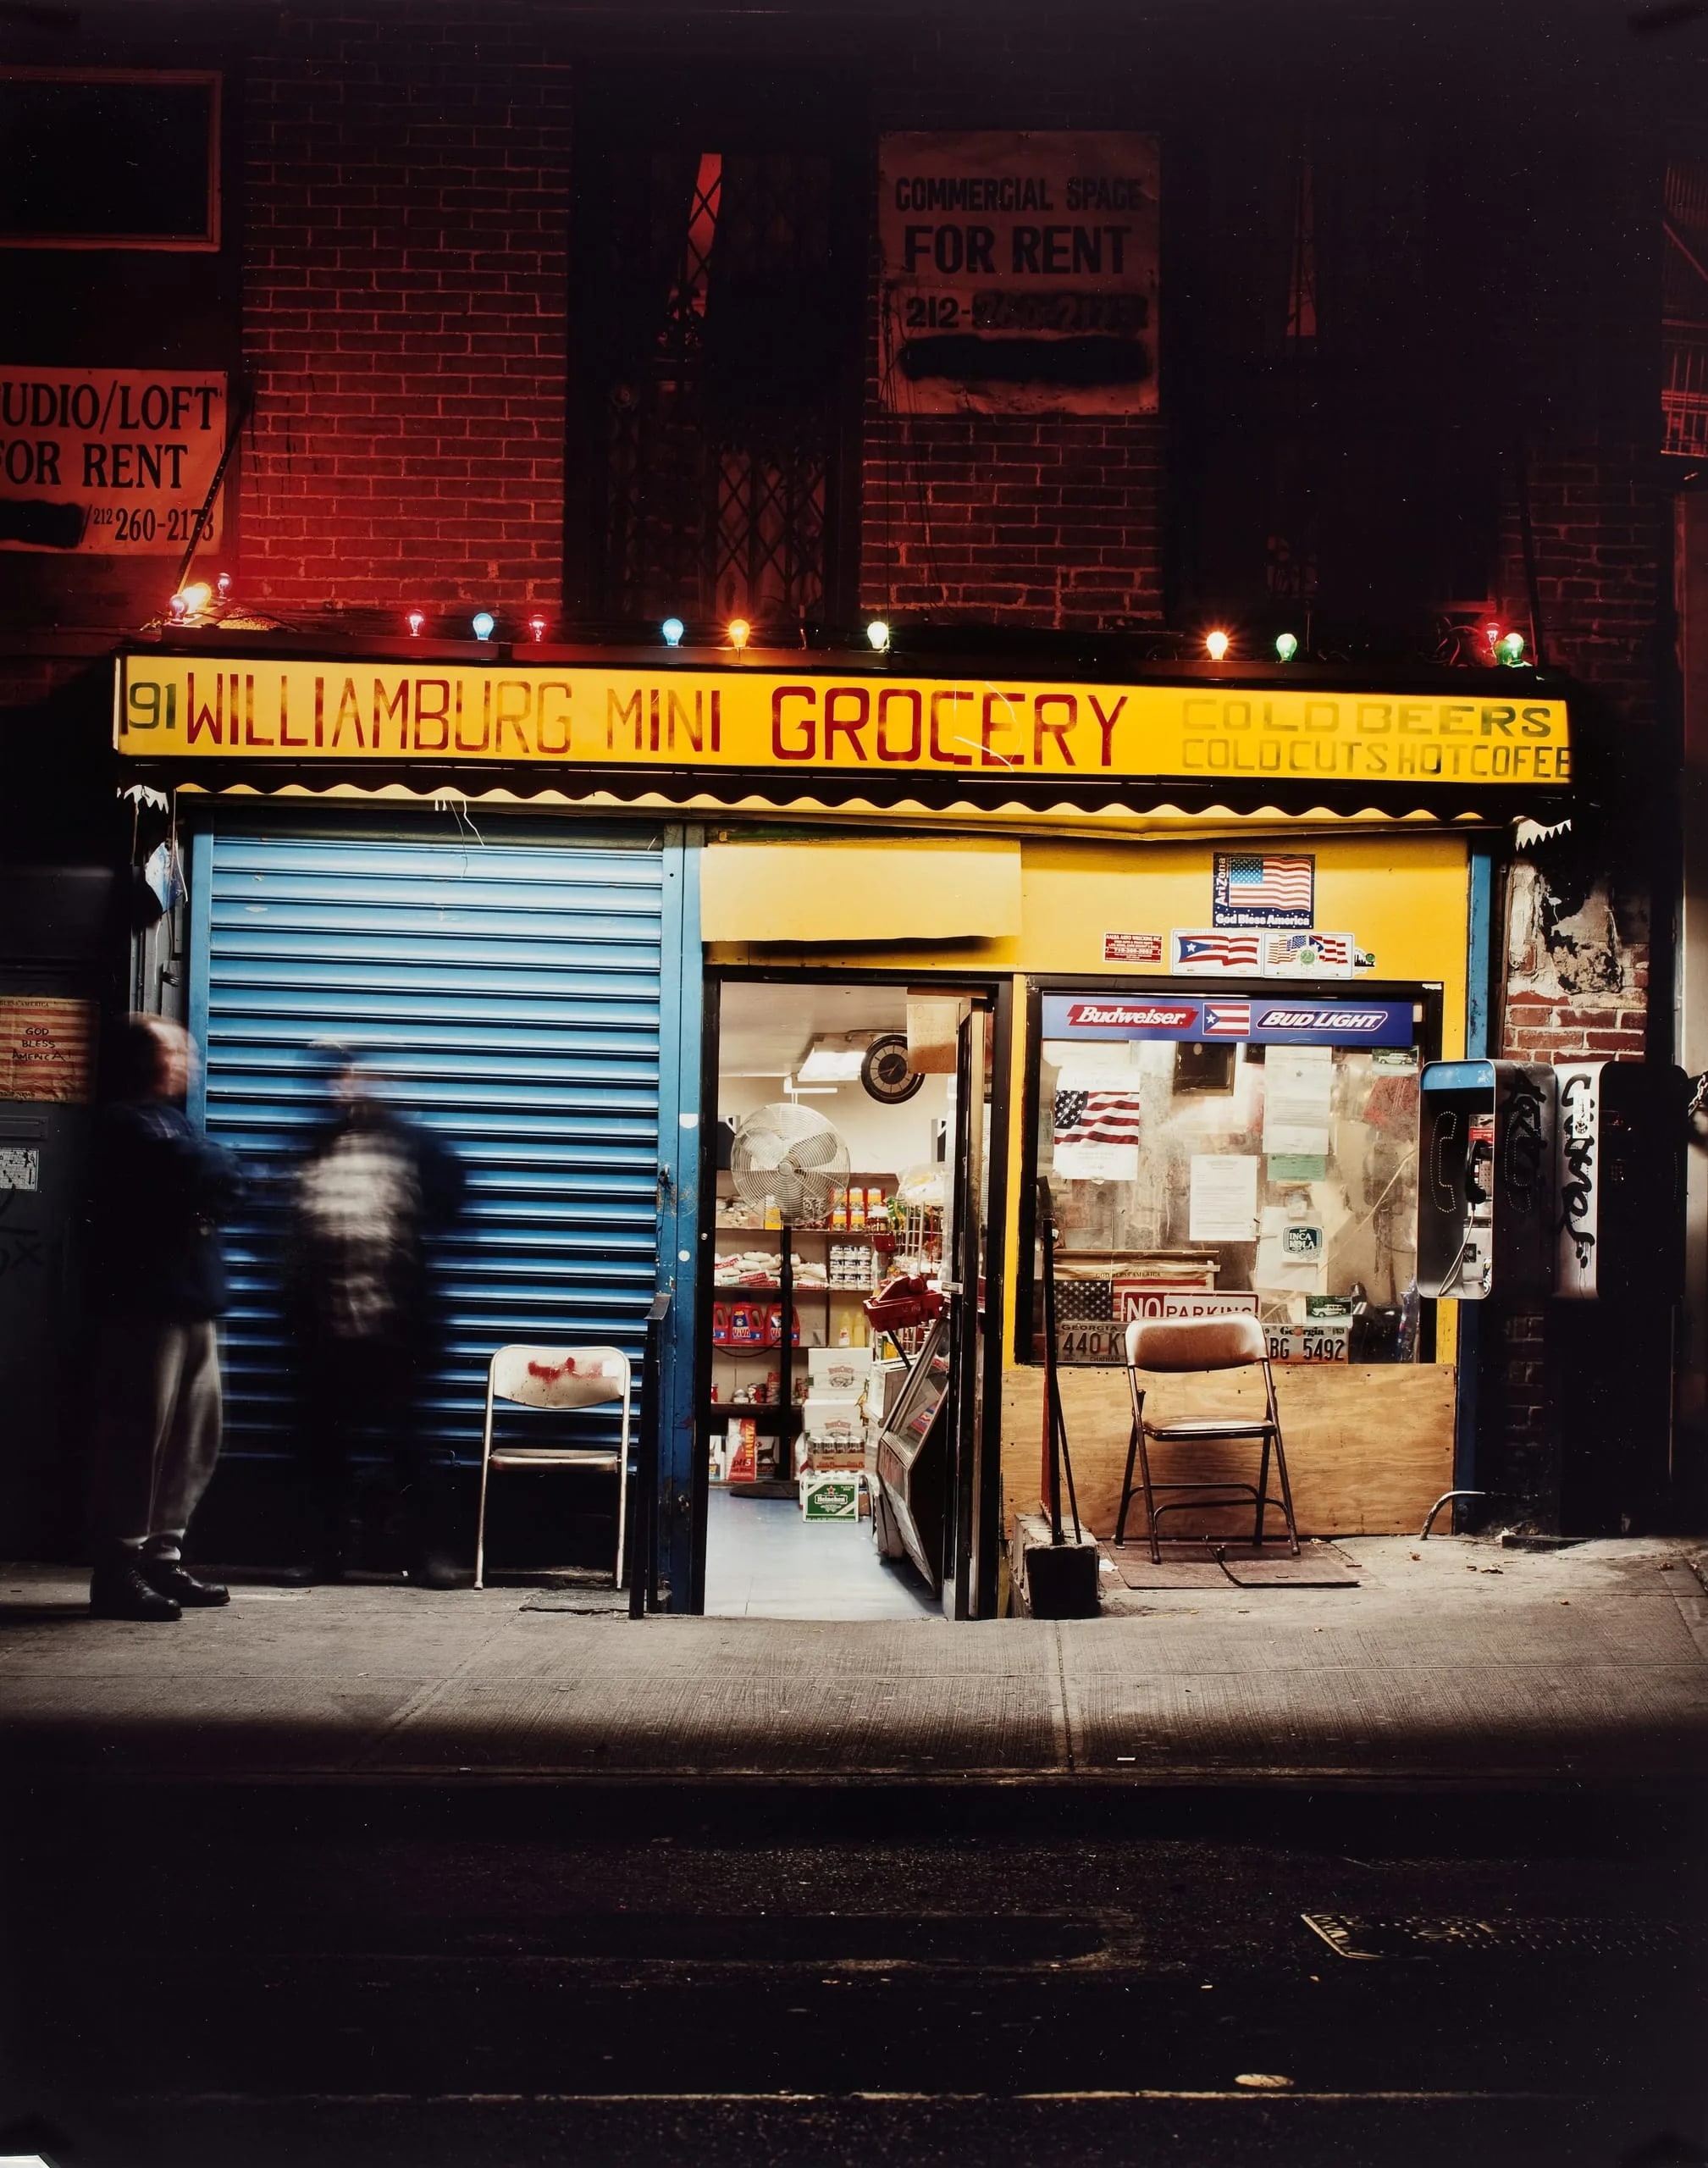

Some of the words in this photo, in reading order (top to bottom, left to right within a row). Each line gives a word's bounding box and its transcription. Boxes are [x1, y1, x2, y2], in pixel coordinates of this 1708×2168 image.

[896, 176, 1054, 212] COMMERCIAL
[1067, 176, 1143, 212] SPACE
[904, 224, 997, 274] FOR
[1012, 224, 1132, 274] RENT
[0, 380, 218, 434] UDIO/LOFT
[0, 440, 62, 486] OR
[81, 443, 188, 489] RENT
[129, 682, 177, 730] 91
[187, 672, 573, 755] WILLIAMBURG
[606, 688, 721, 753] MINI
[771, 685, 1129, 767] GROCERY
[1182, 698, 1340, 733] COLD
[1356, 702, 1551, 738] BEERS
[1214, 857, 1228, 907] AriZona
[1215, 913, 1237, 925] God
[1238, 914, 1266, 925] Bless
[1267, 915, 1310, 926] America
[1076, 1006, 1186, 1026] Budweiser
[1266, 1010, 1315, 1028] BUD
[1316, 1010, 1380, 1029] LIGHT
[22, 1039, 55, 1048] BLESS
[25, 1027, 49, 1036] GOD
[1289, 1232, 1312, 1241] INCA
[1289, 1240, 1315, 1248] KOLA
[1127, 1297, 1161, 1321] NO
[1166, 1305, 1252, 1317] PARK
[1062, 1331, 1101, 1356] 440
[1280, 1326, 1324, 1337] Georgia
[1303, 1337, 1345, 1362] 5492
